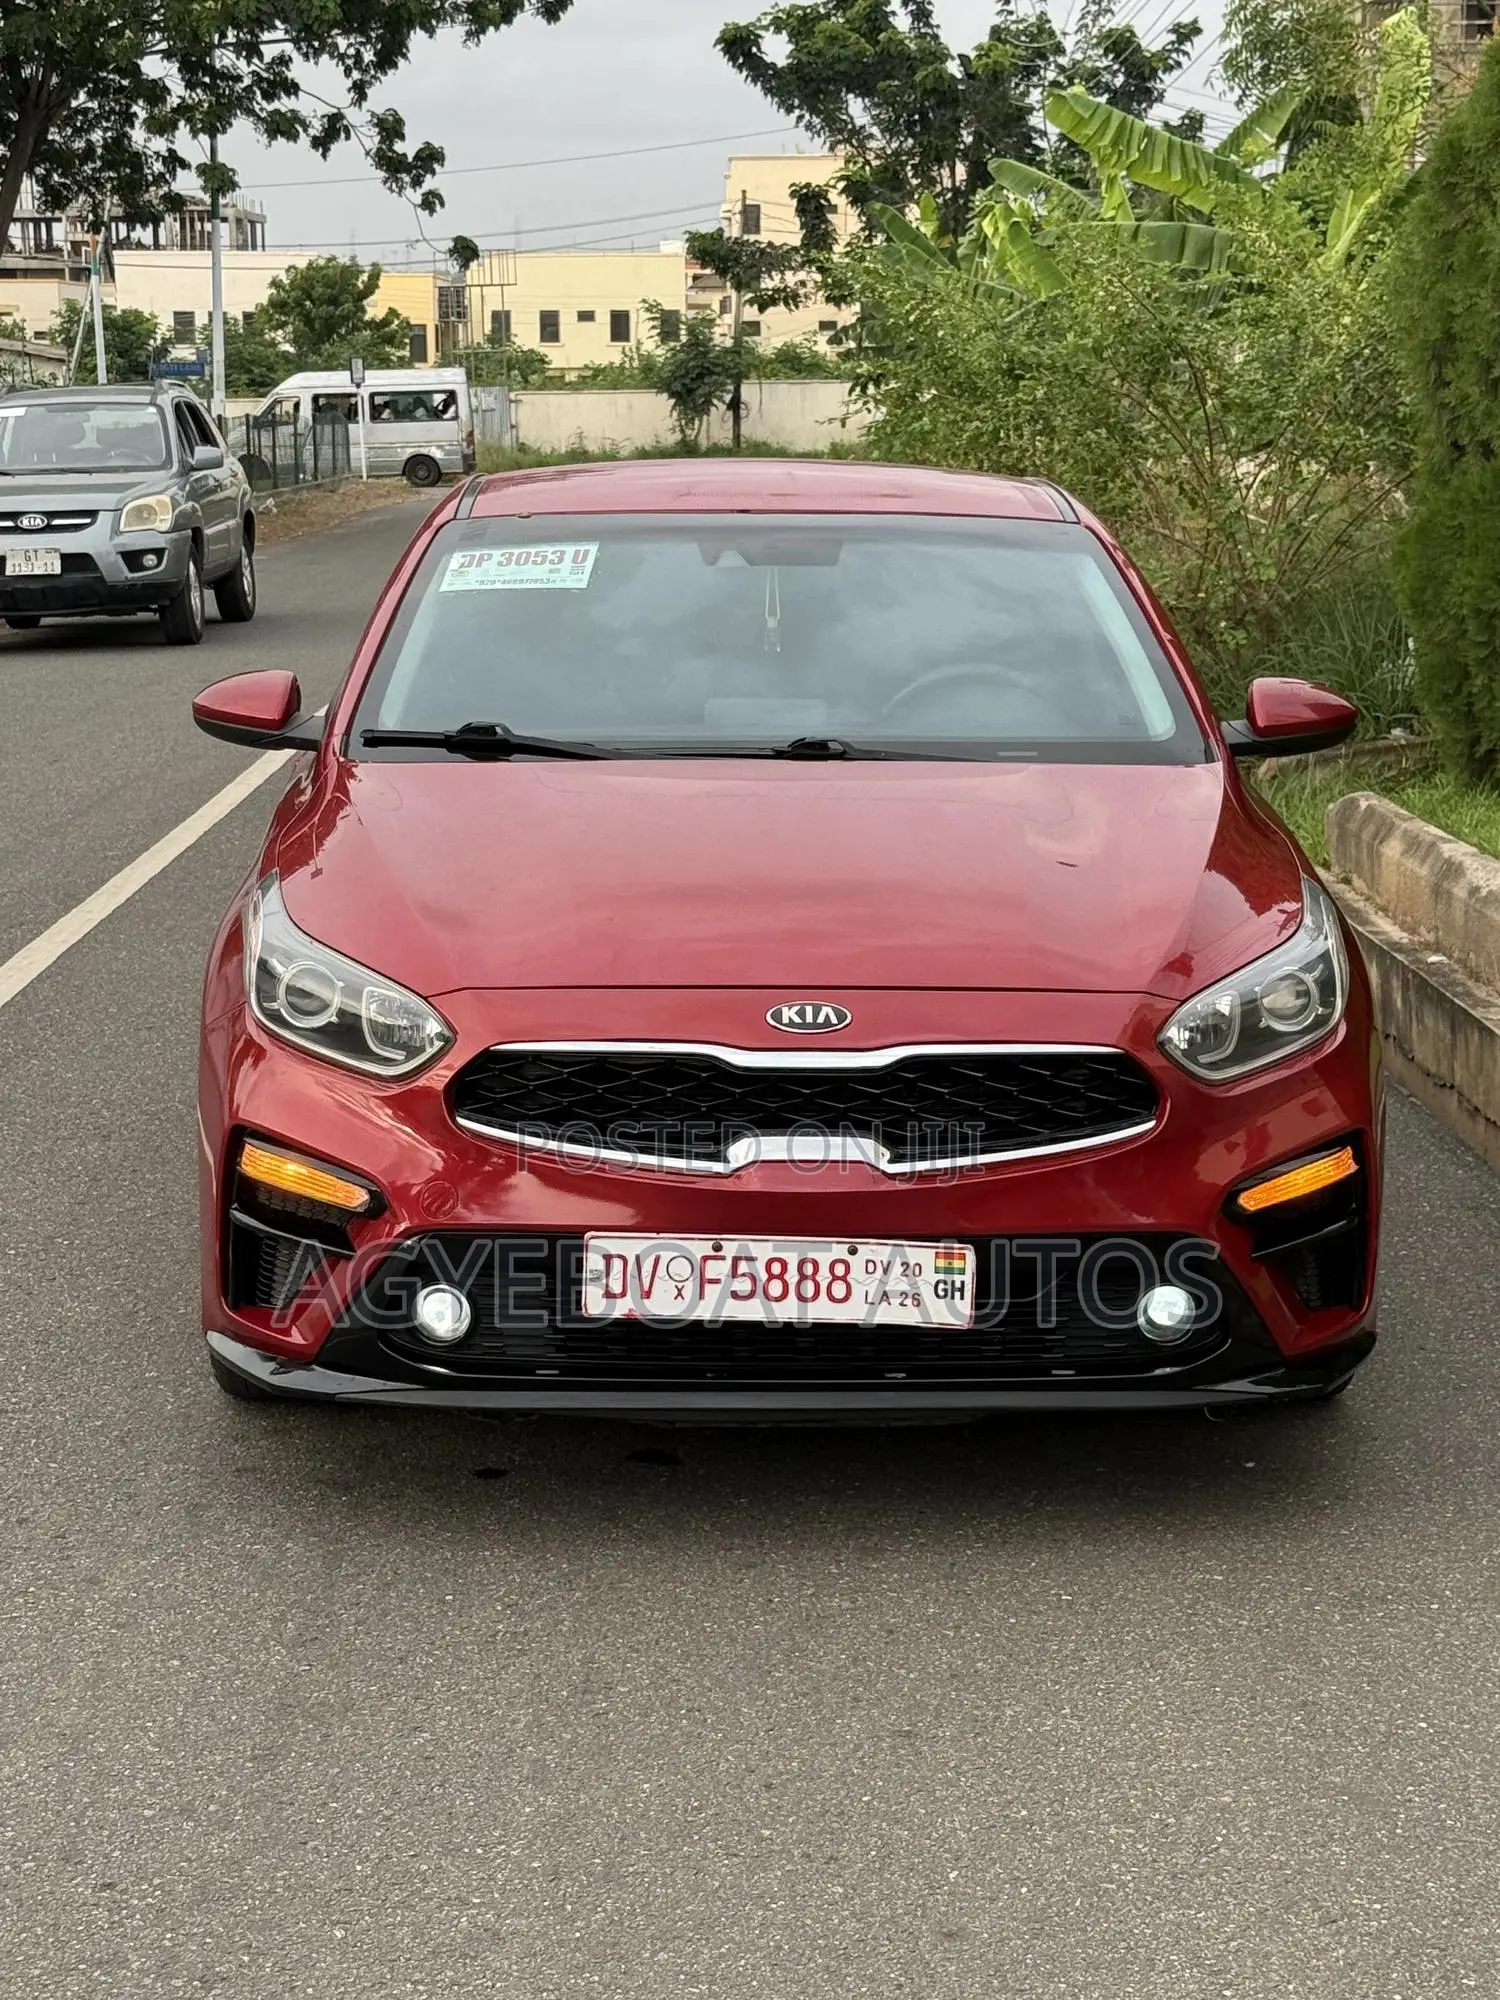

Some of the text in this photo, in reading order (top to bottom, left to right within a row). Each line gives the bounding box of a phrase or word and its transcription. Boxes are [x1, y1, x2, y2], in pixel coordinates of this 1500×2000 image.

[22, 517, 43, 526] KIA
[24, 550, 39, 562] GT
[497, 550, 567, 567] 3053
[571, 549, 591, 565] U
[781, 1005, 839, 1024] KIA
[601, 1253, 661, 1300] DV
[864, 1259, 923, 1278] DV 20
[863, 1289, 922, 1308] LA 26
[934, 1279, 966, 1301] GH
